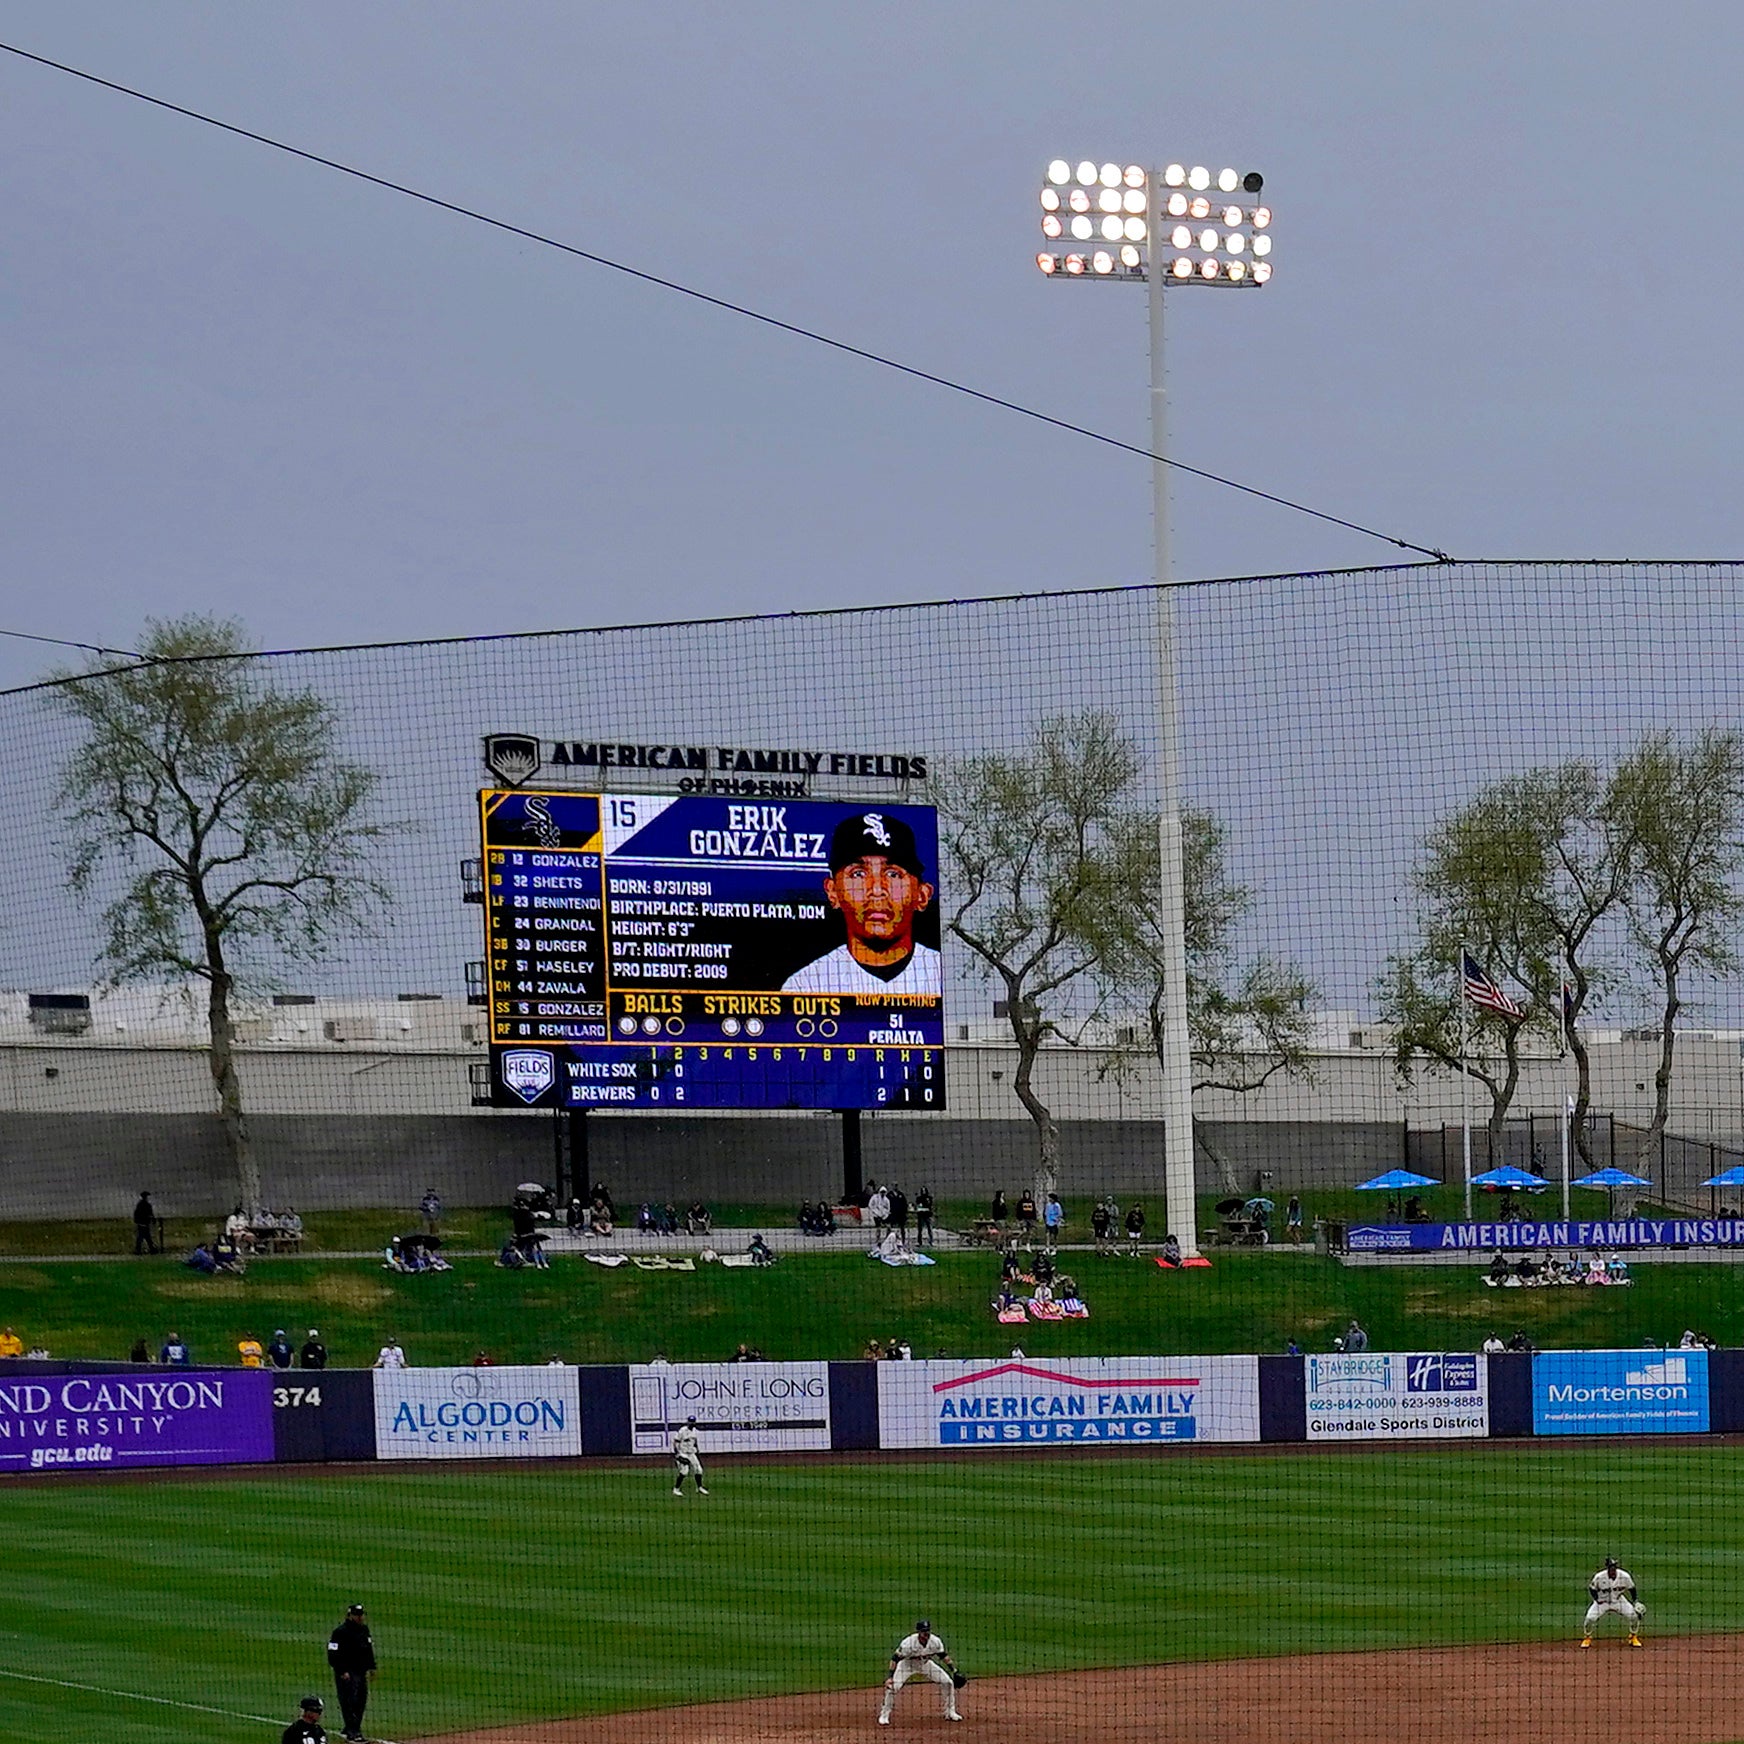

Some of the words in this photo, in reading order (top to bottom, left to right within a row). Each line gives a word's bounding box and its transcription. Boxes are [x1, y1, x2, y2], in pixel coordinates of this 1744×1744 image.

[550, 742, 707, 770] AMERICAN
[716, 748, 823, 775] FAMILY
[830, 752, 928, 779] FIELDS
[679, 777, 705, 793] OF
[611, 801, 636, 827] 15
[728, 806, 786, 831] ERIK
[690, 828, 827, 859] GONZÁLEZ
[532, 854, 599, 868] GONZALEZ
[513, 875, 528, 887] 32
[533, 876, 583, 889] SHEETS
[610, 879, 651, 895] BORN:
[492, 896, 505, 907] LF
[514, 896, 529, 908] 23
[534, 896, 601, 910] BENINTENDI
[611, 901, 699, 917] BIRTHPLACE:
[702, 902, 750, 918] PUERTO
[753, 903, 796, 920] PLATA,
[799, 904, 826, 919] DOM
[493, 917, 500, 928] C
[514, 918, 530, 929] 24
[535, 918, 596, 931] GRANDAL
[612, 921, 666, 936] HEIGHT:
[536, 940, 588, 953] BURGER
[612, 942, 641, 956] B/T:
[643, 943, 732, 958] RIGHT/RIGHT
[536, 961, 594, 974] HASELEY
[613, 962, 640, 977] PRO
[643, 963, 692, 978] DEBUT:
[694, 964, 728, 979] 2009
[517, 981, 533, 993] 44
[537, 982, 587, 994] ZAVALA
[496, 1002, 511, 1014] SS
[538, 1003, 604, 1016] GONZALEZ
[624, 994, 683, 1013] BALLS
[704, 996, 781, 1015] STRIKES
[793, 997, 841, 1015] OUTS
[856, 994, 883, 1006] NOW
[885, 995, 936, 1008] PITCHING
[889, 1014, 903, 1028] 51
[497, 1023, 511, 1035] RF
[539, 1024, 606, 1037] REMILLARD
[868, 1030, 924, 1044] PERALTA
[724, 1048, 732, 1060] 4
[749, 1049, 757, 1060] 5
[773, 1049, 781, 1061] 6
[799, 1049, 807, 1061] 7
[823, 1049, 831, 1061] 8
[847, 1050, 855, 1062] 9
[876, 1050, 884, 1062] R
[901, 1051, 910, 1062] H
[924, 1051, 932, 1062] E
[508, 1060, 549, 1076] FIELDS
[567, 1063, 609, 1077] WHITE
[611, 1064, 637, 1077] SOX
[675, 1065, 683, 1078] 0
[924, 1066, 932, 1079] 0
[571, 1087, 635, 1100] BREWERS
[651, 1087, 659, 1100] 0
[676, 1088, 684, 1100] 2
[878, 1088, 886, 1101] 2
[925, 1088, 933, 1101] 0
[1442, 1223, 1569, 1247] AMERICAN
[1578, 1222, 1666, 1245] FAMILY
[1318, 1360, 1382, 1376] STAYBRIDGE
[61, 1380, 223, 1412] CANYON
[672, 1379, 736, 1400] JOHN
[761, 1378, 825, 1399] LONG
[1549, 1384, 1688, 1402] Mortenson
[272, 1387, 322, 1408] 374
[940, 1395, 1085, 1418] AMERICAN
[1098, 1393, 1196, 1415] FAMILY
[1309, 1397, 1396, 1411] 623-842-0000
[1402, 1396, 1484, 1408] 623-939-8888
[393, 1396, 565, 1433] ALGODÓN
[697, 1404, 802, 1418] PROPERTIES
[960, 1421, 1177, 1440] INSURANCE
[1311, 1419, 1376, 1433] Glendale
[1380, 1417, 1428, 1433] Sports
[1433, 1416, 1485, 1429] District
[428, 1430, 530, 1442] CENTER
[30, 1444, 113, 1468] gcu.edu
